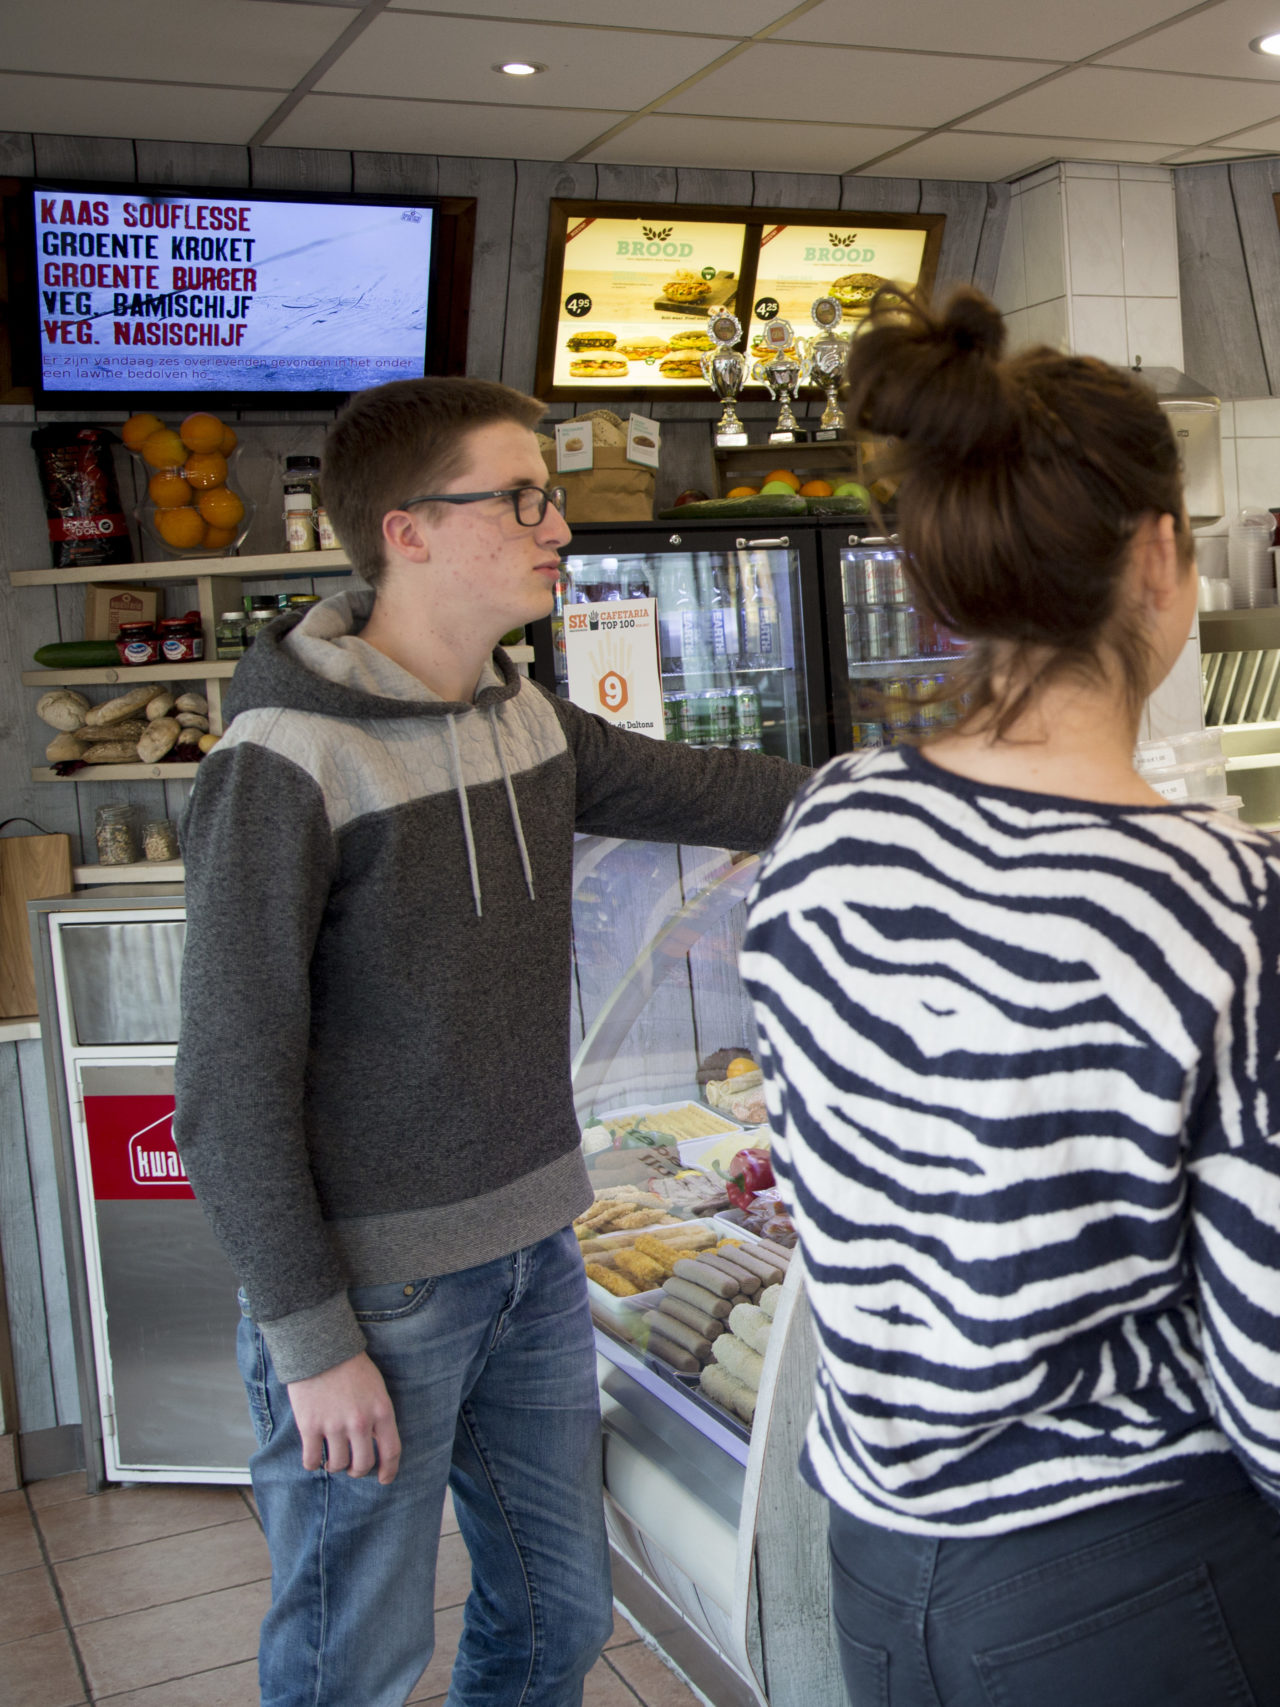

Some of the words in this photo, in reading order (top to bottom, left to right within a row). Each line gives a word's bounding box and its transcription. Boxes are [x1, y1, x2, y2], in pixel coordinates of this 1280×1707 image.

[41, 199, 109, 226] KAAS
[123, 203, 251, 232] SOUFLESSE
[42, 231, 158, 260] GROENTE
[171, 236, 256, 263] KROKET
[615, 240, 693, 258] BROOD
[803, 247, 876, 263] BROOD
[43, 262, 160, 290] GROENTE
[172, 266, 258, 292] BURGER
[42, 290, 99, 318] VEG.
[113, 292, 253, 320] BAMISCHIJF
[567, 298, 591, 315] 4,95
[756, 303, 778, 318] 4,25
[43, 320, 100, 346] VEG.
[113, 321, 248, 347] NASISCHIJF
[43, 356, 57, 365] Er
[63, 355, 89, 367] zijn
[94, 355, 154, 367] vandaag
[158, 357, 180, 366] zes
[42, 370, 72, 379] een
[127, 369, 188, 379] bedolven
[568, 613, 588, 629] SK
[600, 608, 649, 621] CAFETARIA
[601, 621, 618, 630] TOP
[620, 619, 636, 629] 100
[712, 608, 727, 656] EARTH
[604, 675, 623, 707] 9
[626, 721, 654, 729] Daltons
